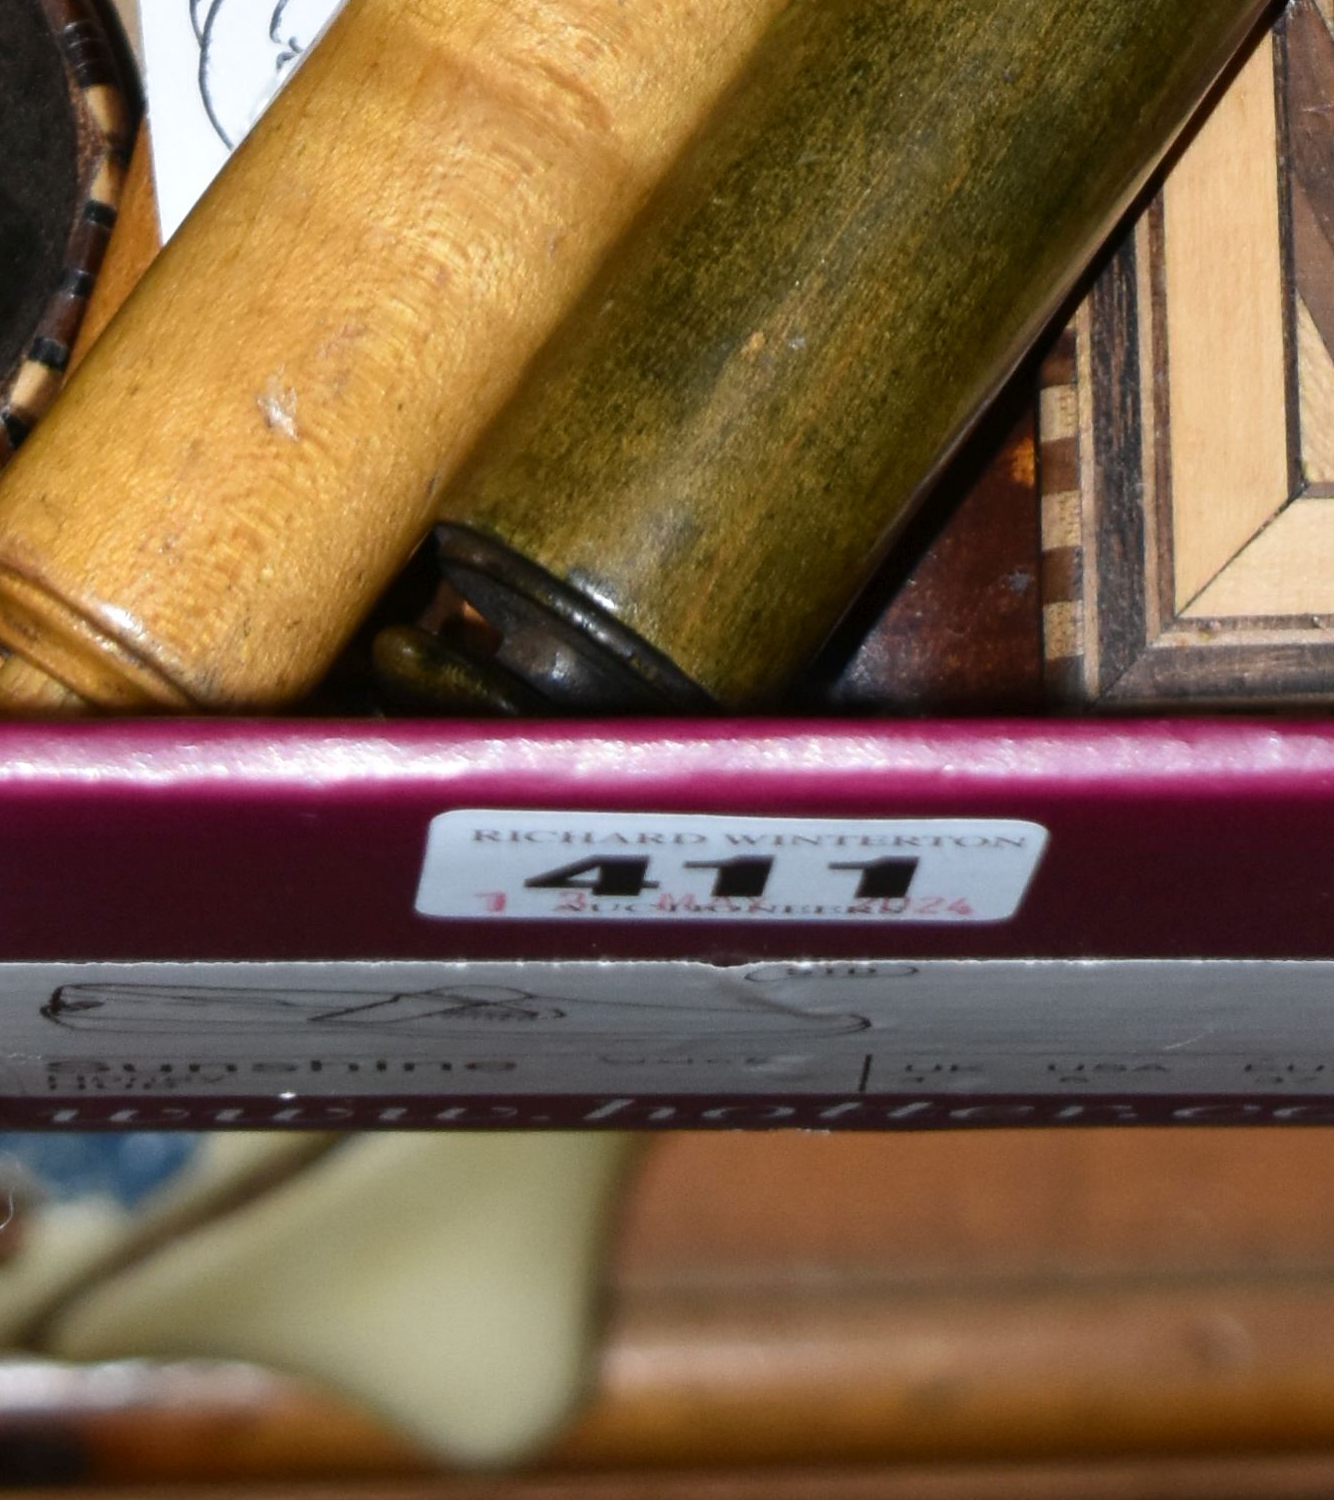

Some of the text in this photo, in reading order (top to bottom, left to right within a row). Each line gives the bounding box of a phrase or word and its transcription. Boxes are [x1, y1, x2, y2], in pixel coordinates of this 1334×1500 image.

[471, 829, 1028, 850] RICHARD WINTERTON
[523, 854, 922, 899] 411
[46, 1058, 518, 1073] Sunshine
